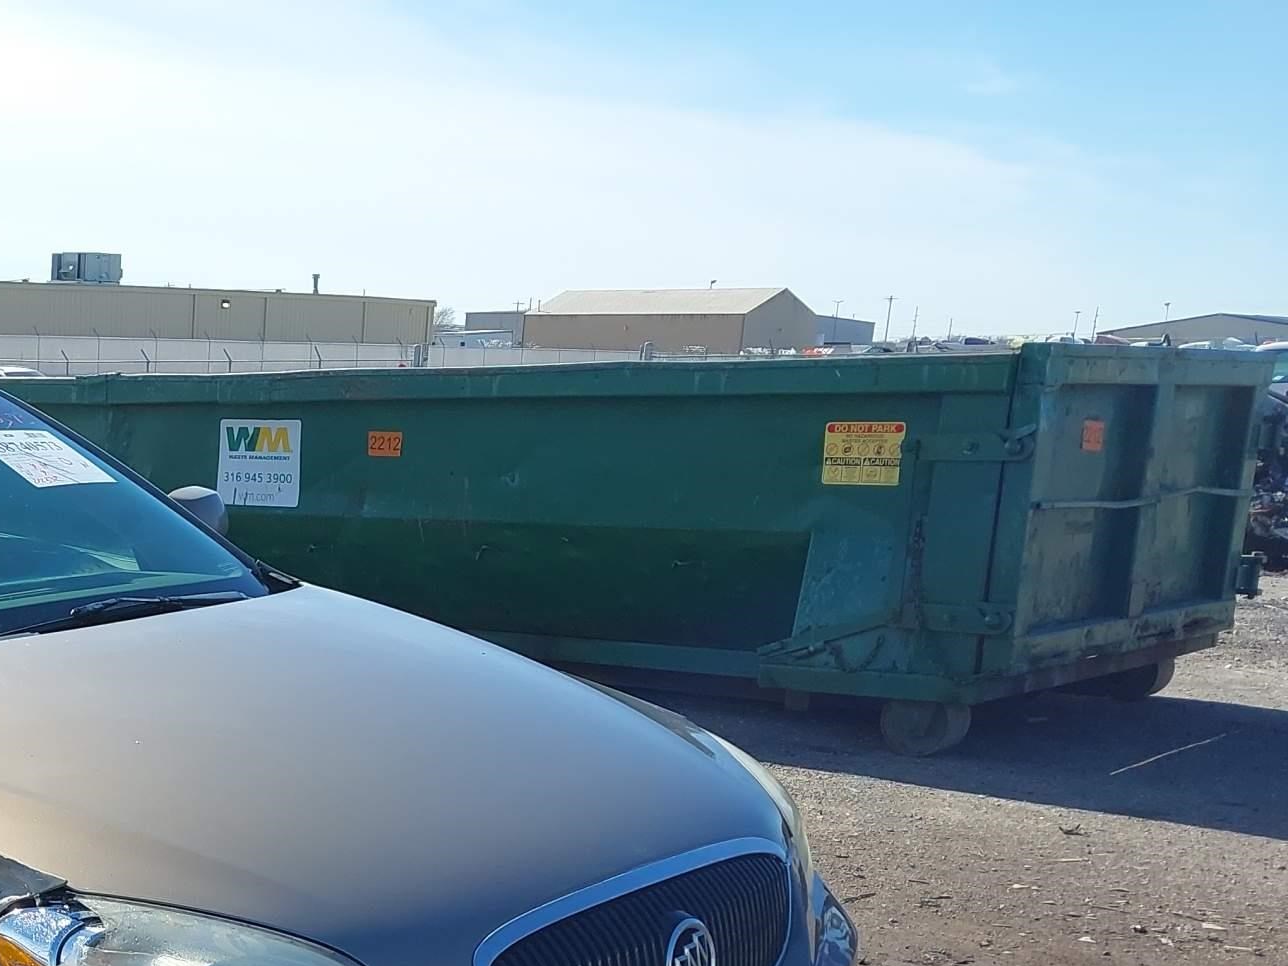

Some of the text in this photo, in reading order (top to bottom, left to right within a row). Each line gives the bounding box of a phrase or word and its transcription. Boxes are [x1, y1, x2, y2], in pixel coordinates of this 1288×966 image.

[834, 424, 897, 432] DO NOT PARK
[226, 426, 292, 452] WM
[370, 435, 401, 451] 2212
[224, 472, 292, 484] 316 945 3900
